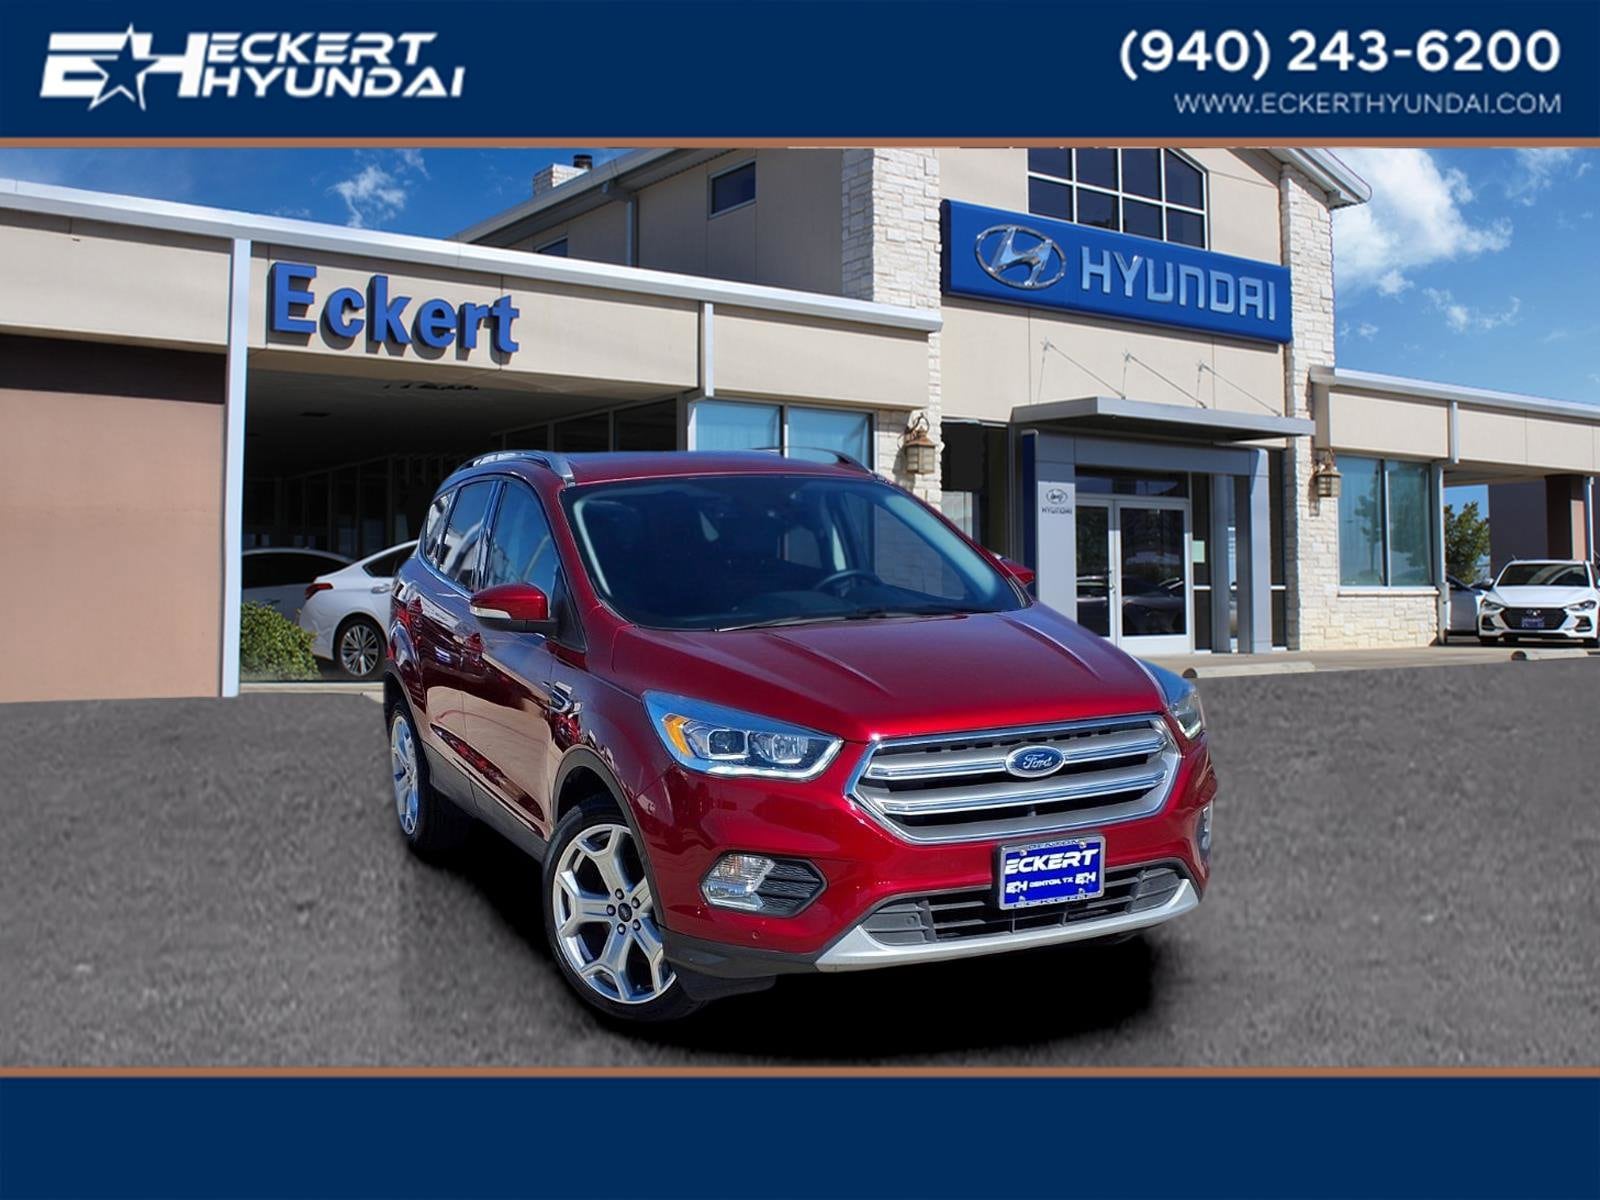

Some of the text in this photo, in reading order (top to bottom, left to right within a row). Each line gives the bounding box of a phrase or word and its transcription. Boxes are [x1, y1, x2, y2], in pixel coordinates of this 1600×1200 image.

[270, 262, 520, 353] Eckert
[1080, 246, 1276, 321] HYUNDAI
[1022, 753, 1053, 769] Ford
[1005, 849, 1099, 874] ECKERT
